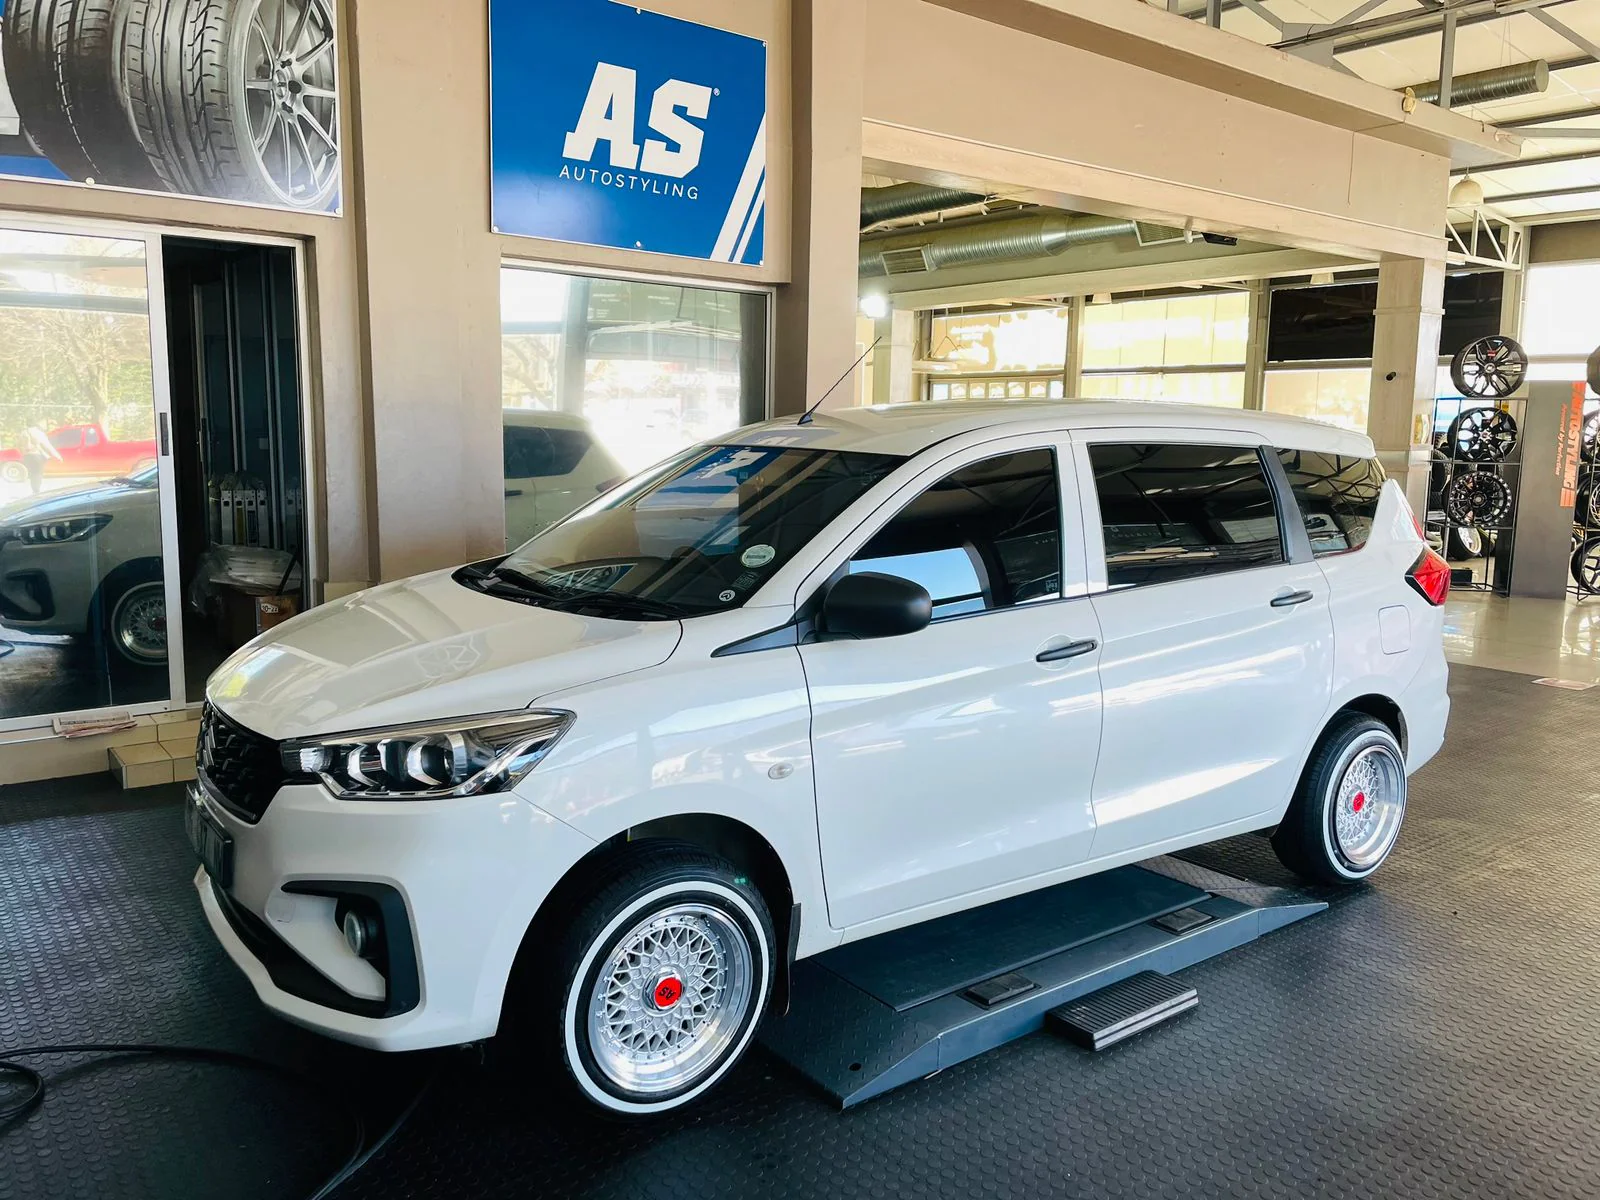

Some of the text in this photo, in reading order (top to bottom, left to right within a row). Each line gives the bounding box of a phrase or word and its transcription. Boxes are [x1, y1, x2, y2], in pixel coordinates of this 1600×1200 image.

[559, 165, 699, 200] AUTOSTYLING
[1555, 442, 1563, 475] Perfection
[1563, 395, 1584, 488] AUTOSTYLING
